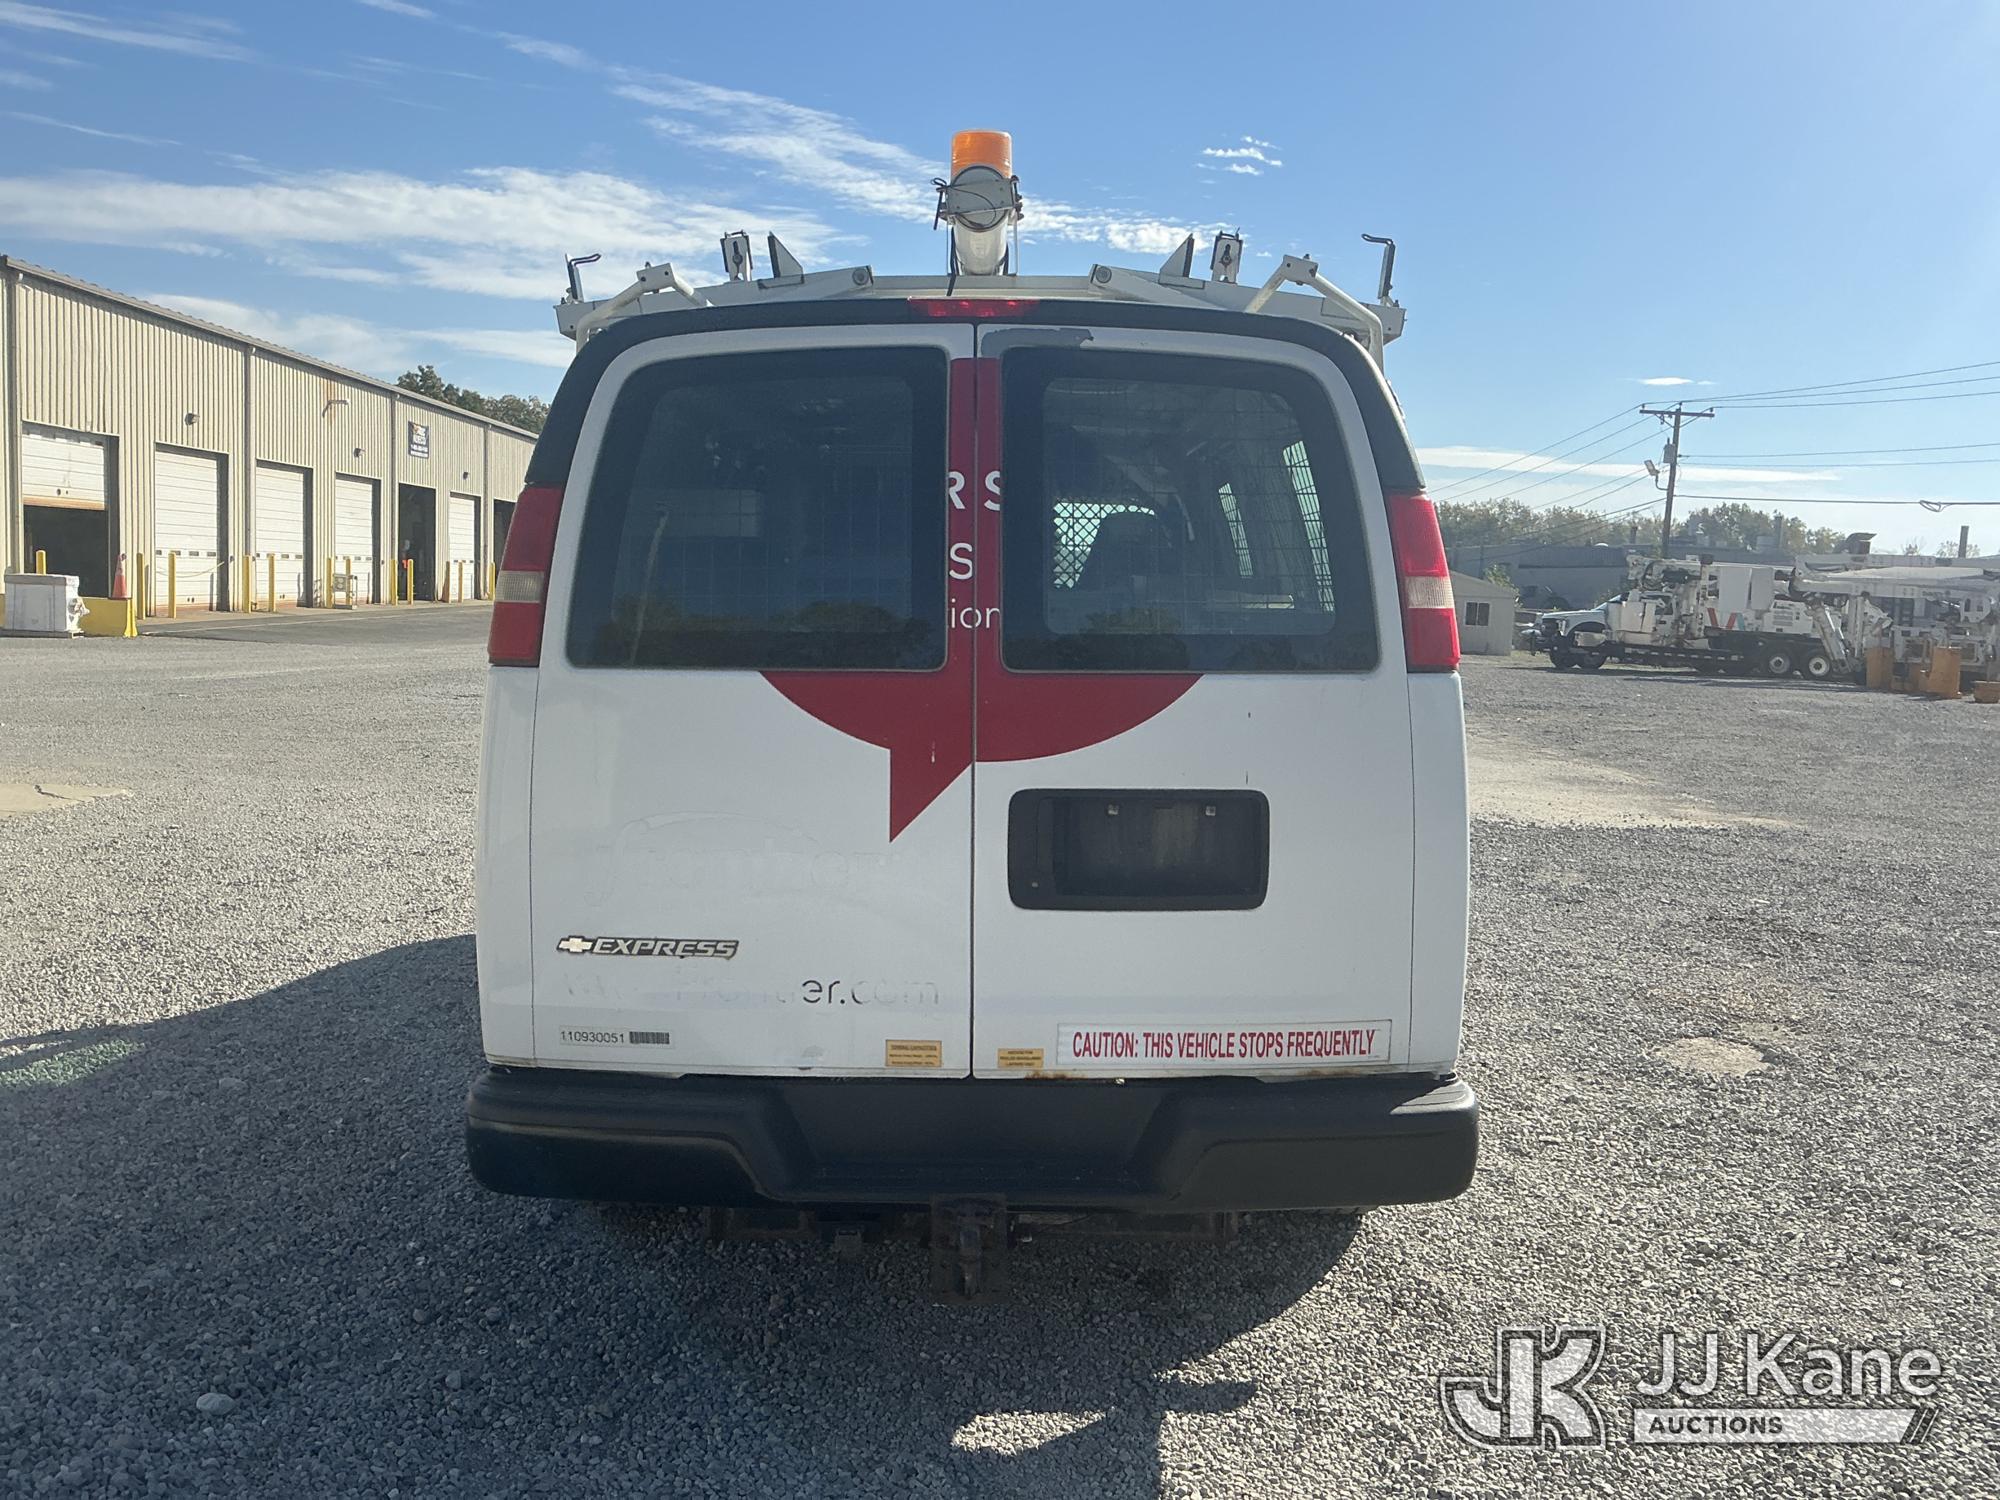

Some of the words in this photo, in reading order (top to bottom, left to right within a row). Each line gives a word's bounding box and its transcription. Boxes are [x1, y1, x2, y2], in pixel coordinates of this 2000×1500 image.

[593, 937, 739, 959] EXPRESS
[560, 1031, 625, 1044] 110930051
[1072, 1030, 1139, 1058] CAUTION:
[1143, 1030, 1173, 1058] THIS
[1177, 1031, 1235, 1058] VEHICLE
[1239, 1030, 1284, 1058] STOPS
[1287, 1029, 1376, 1058] FREQUENTLY
